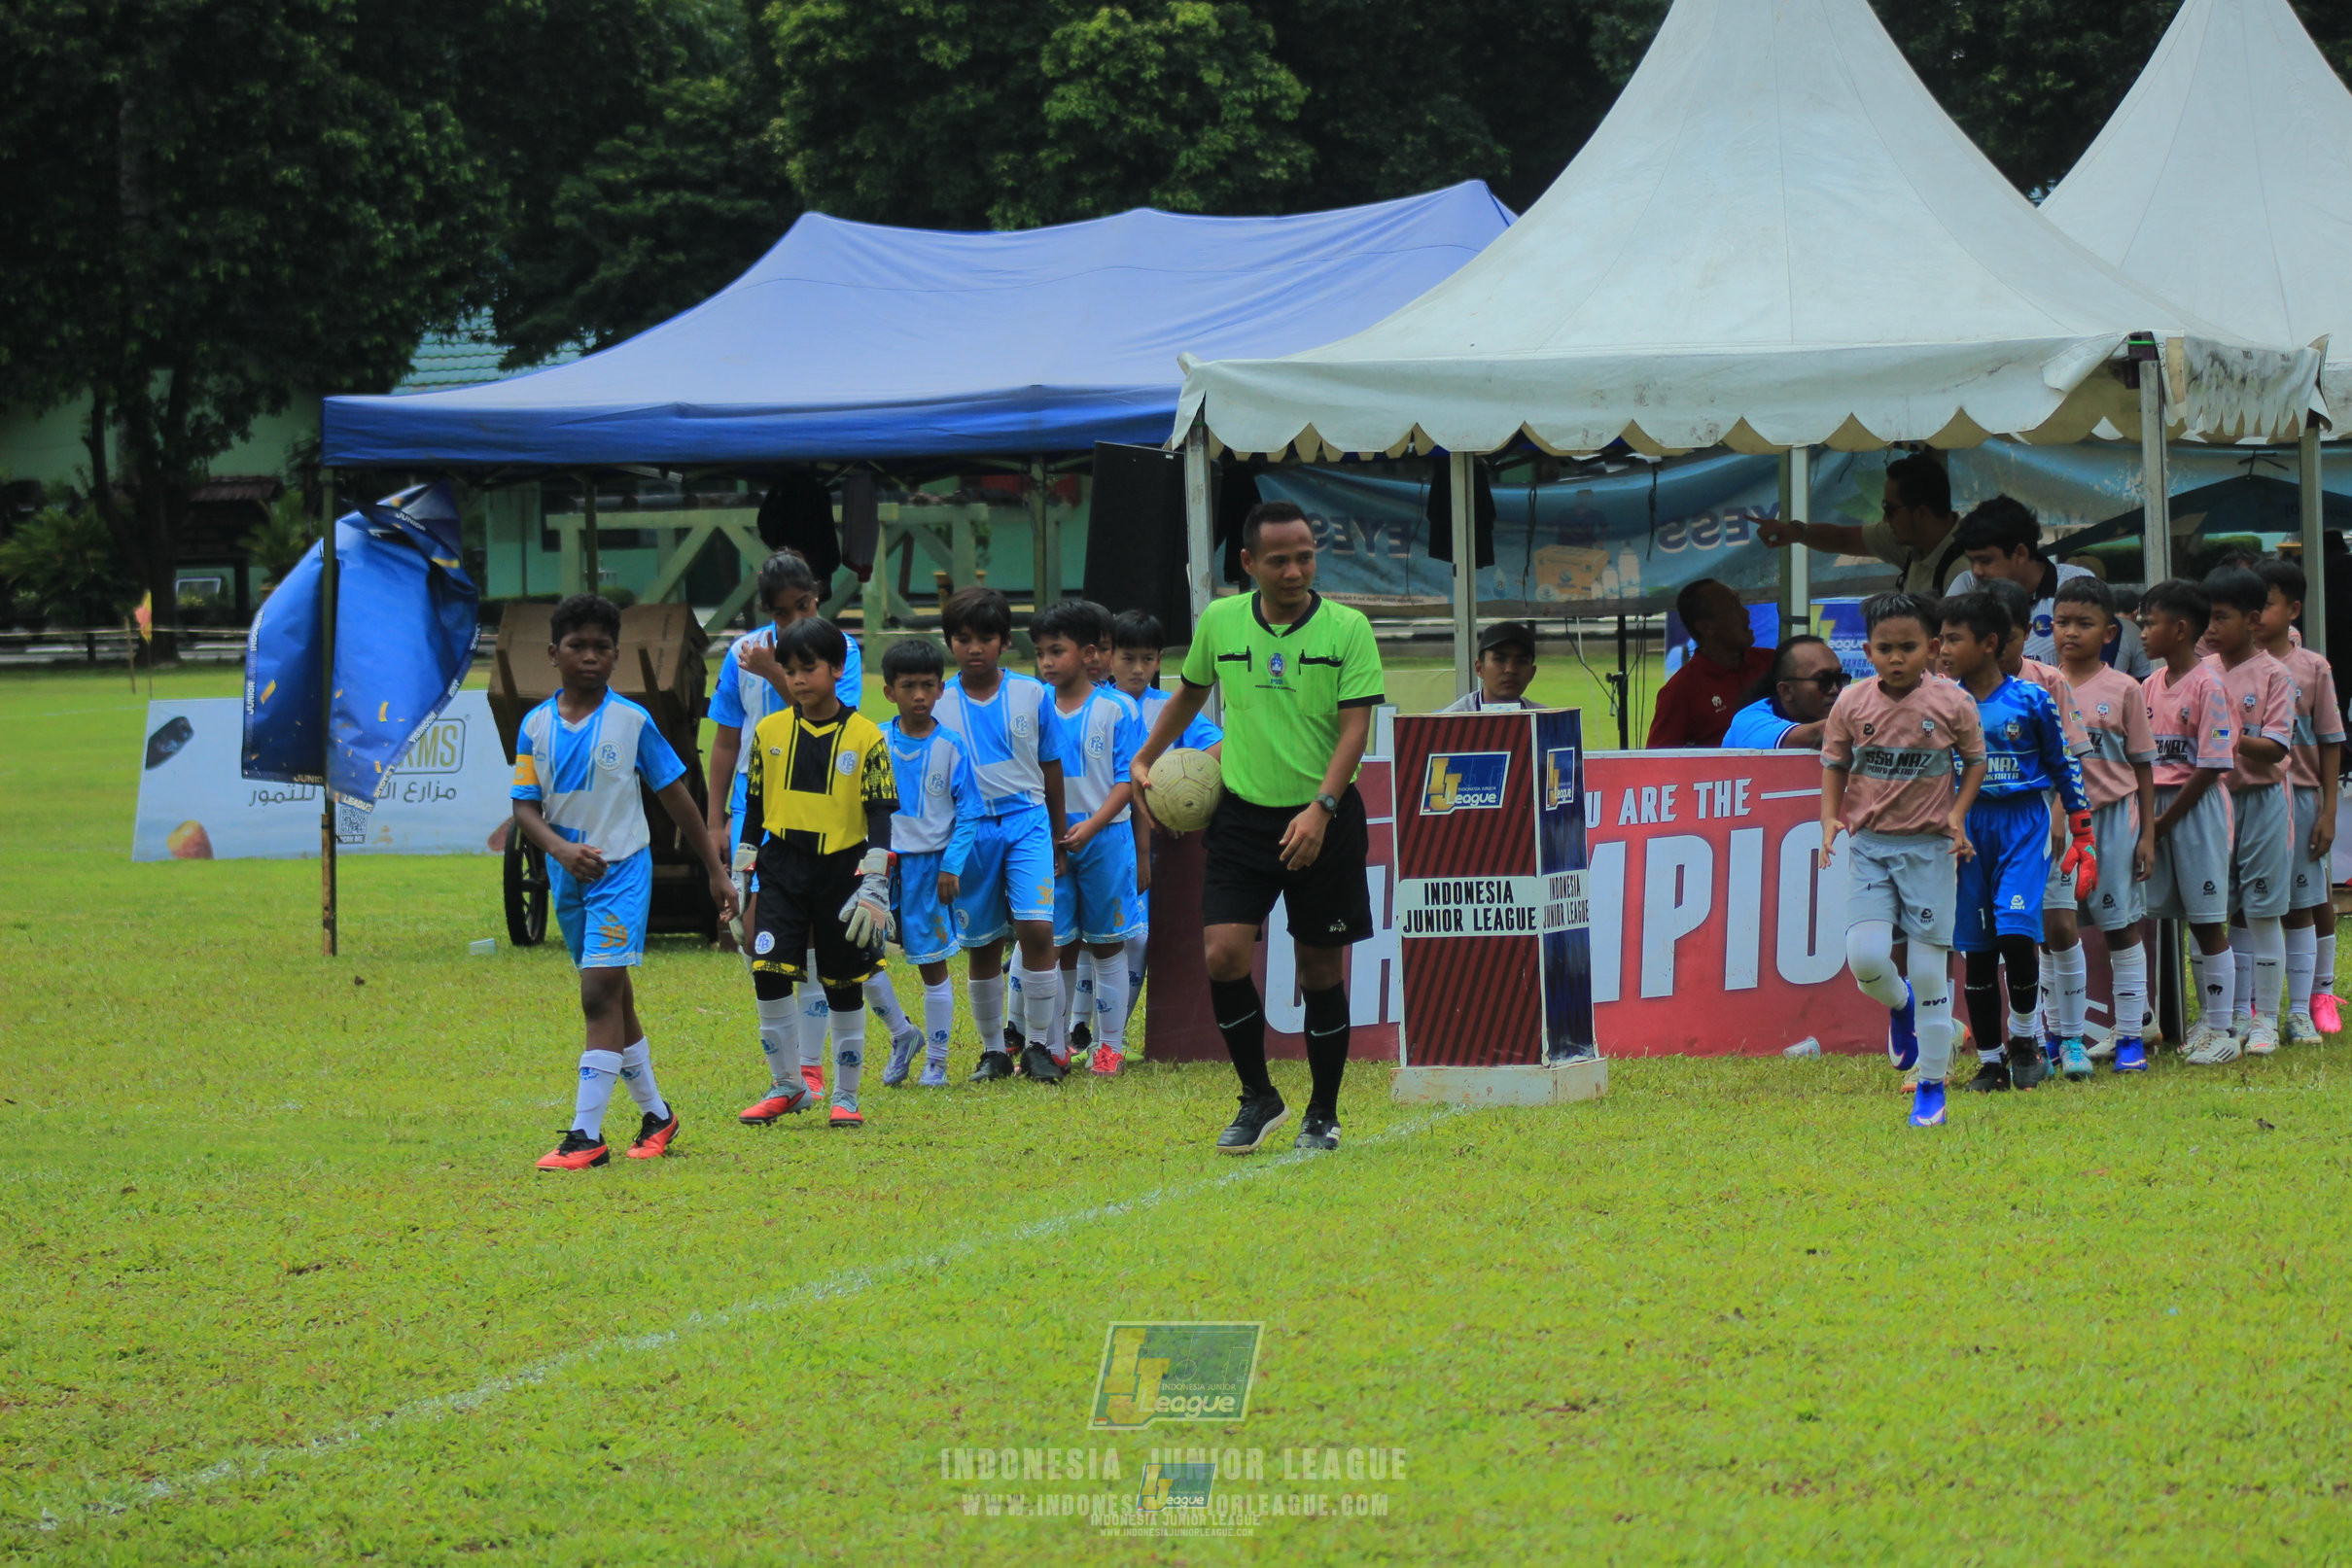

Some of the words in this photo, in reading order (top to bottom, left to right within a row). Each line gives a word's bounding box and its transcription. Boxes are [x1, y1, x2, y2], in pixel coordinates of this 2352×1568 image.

[396, 511, 426, 533] JUNIOR
[246, 680, 256, 715] JUNIOR
[408, 712, 438, 744] INDONESIA
[1897, 752, 1932, 767] NAZ
[1987, 757, 2020, 773] NAZ
[294, 774, 324, 784] JUNIO
[403, 781, 457, 804] مزارع
[1446, 791, 1497, 807] League
[1555, 787, 1572, 801] League
[1618, 784, 1678, 825] ARE
[1694, 778, 1753, 819] THE
[1424, 881, 1514, 906] INDONESIA
[1549, 874, 1581, 901] INDONESIA
[1403, 908, 1463, 933] JUNIOR
[1473, 906, 1538, 931] LEAGUE
[1543, 903, 1564, 929] JUNIOR
[1566, 899, 1590, 924] LEAGUE
[598, 925, 627, 948] 39
